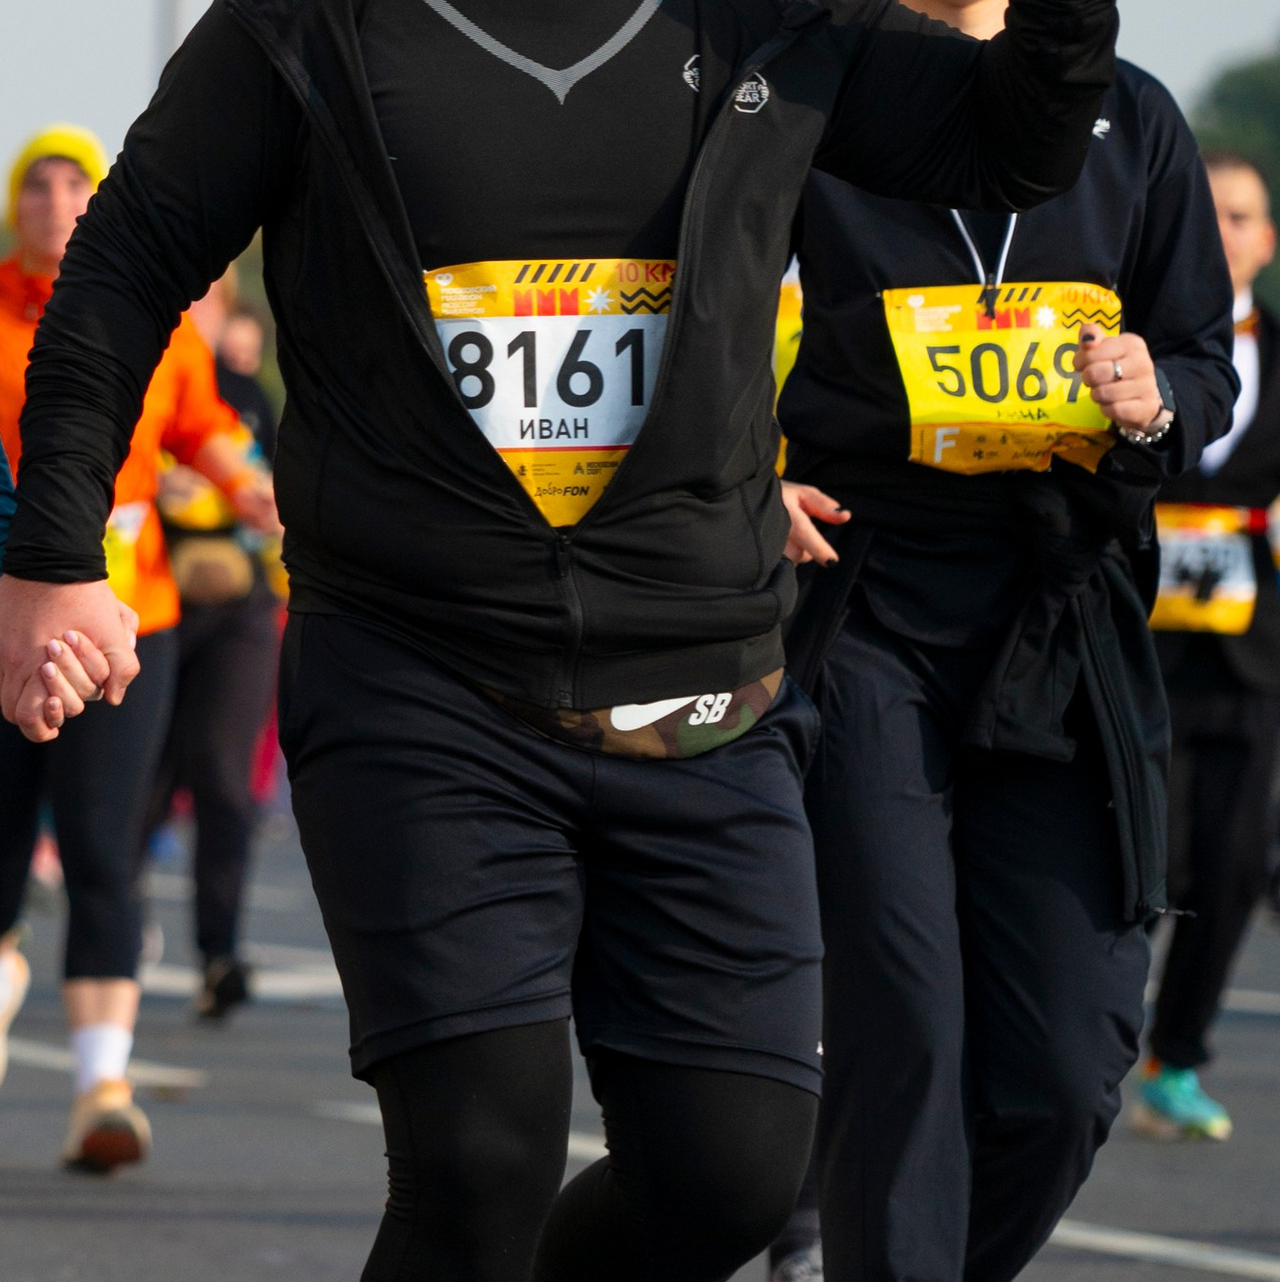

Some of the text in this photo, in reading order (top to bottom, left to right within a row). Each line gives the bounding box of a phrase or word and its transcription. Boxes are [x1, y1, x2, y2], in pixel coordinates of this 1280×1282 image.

[615, 262, 639, 283] 10
[448, 328, 644, 410] 8161
[926, 342, 1082, 404] 5069
[520, 418, 588, 440] ИВАН
[933, 426, 960, 464] F
[688, 692, 733, 726] SB
